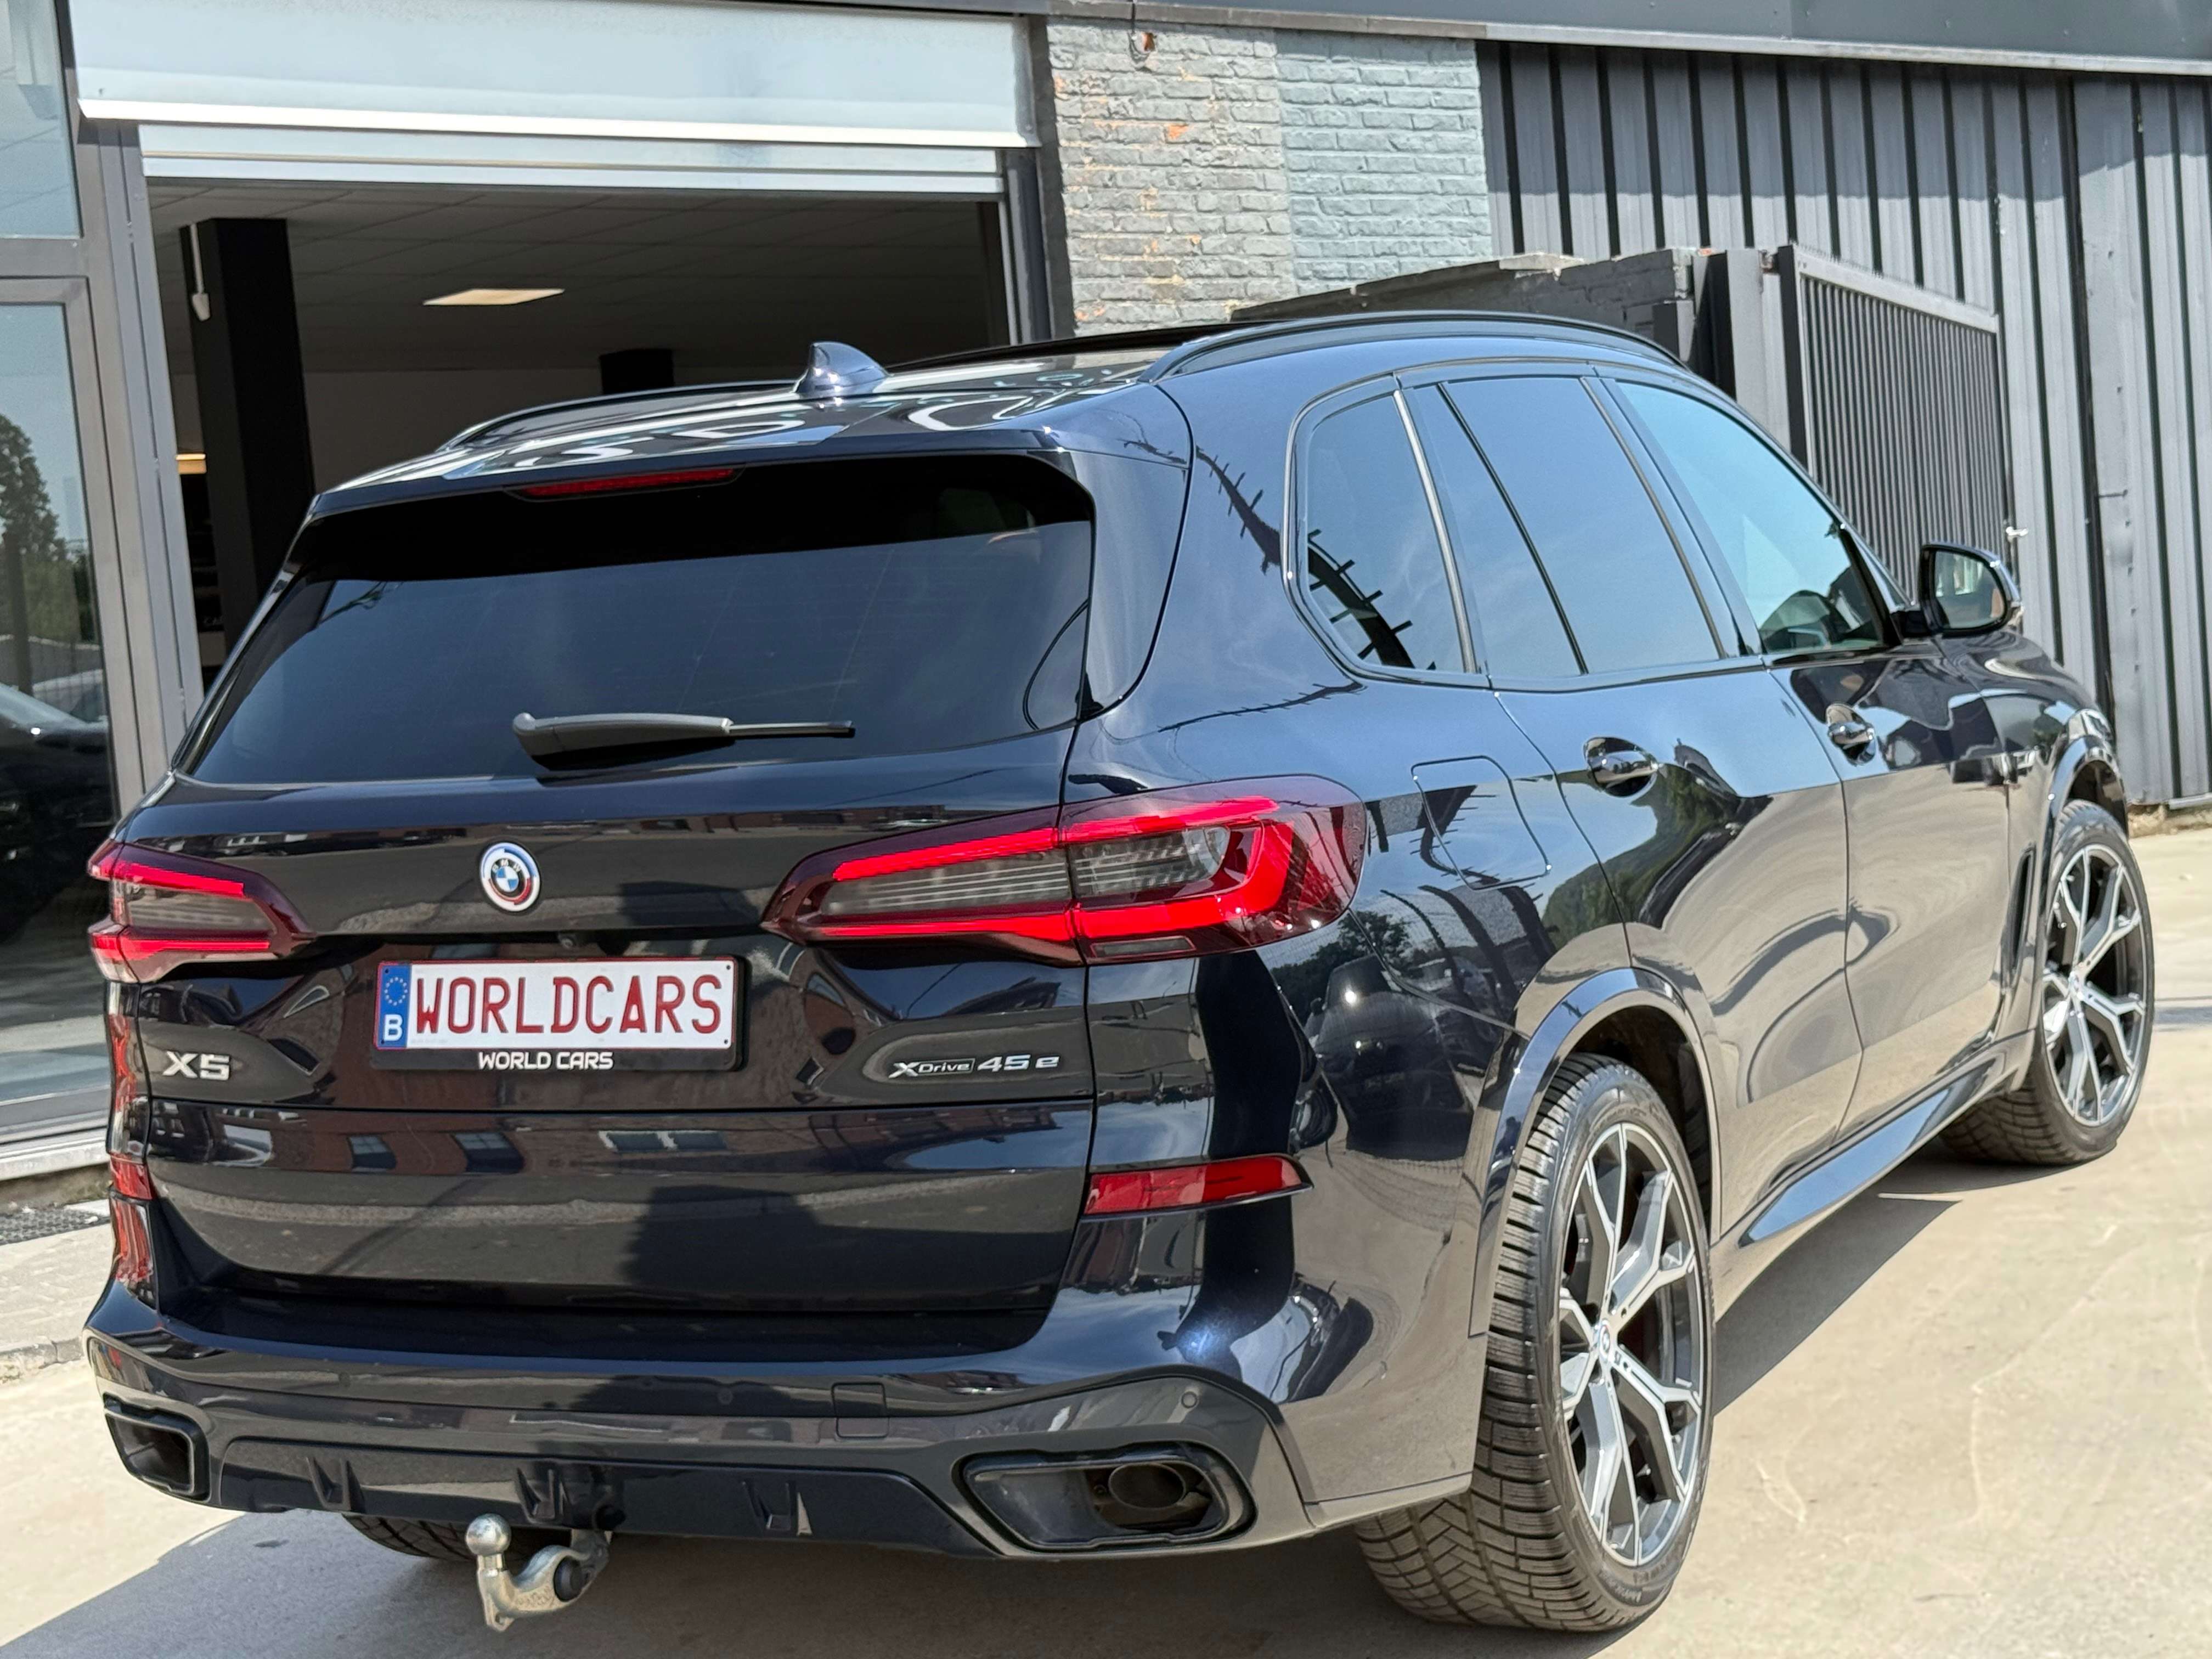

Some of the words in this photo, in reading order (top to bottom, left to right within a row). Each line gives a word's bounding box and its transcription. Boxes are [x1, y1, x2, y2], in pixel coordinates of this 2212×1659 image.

[416, 974, 722, 1035] WORLDCARS
[384, 1014, 403, 1041] B
[162, 1050, 230, 1081] X5
[478, 1051, 552, 1070] WORLD
[556, 1051, 614, 1070] CARS
